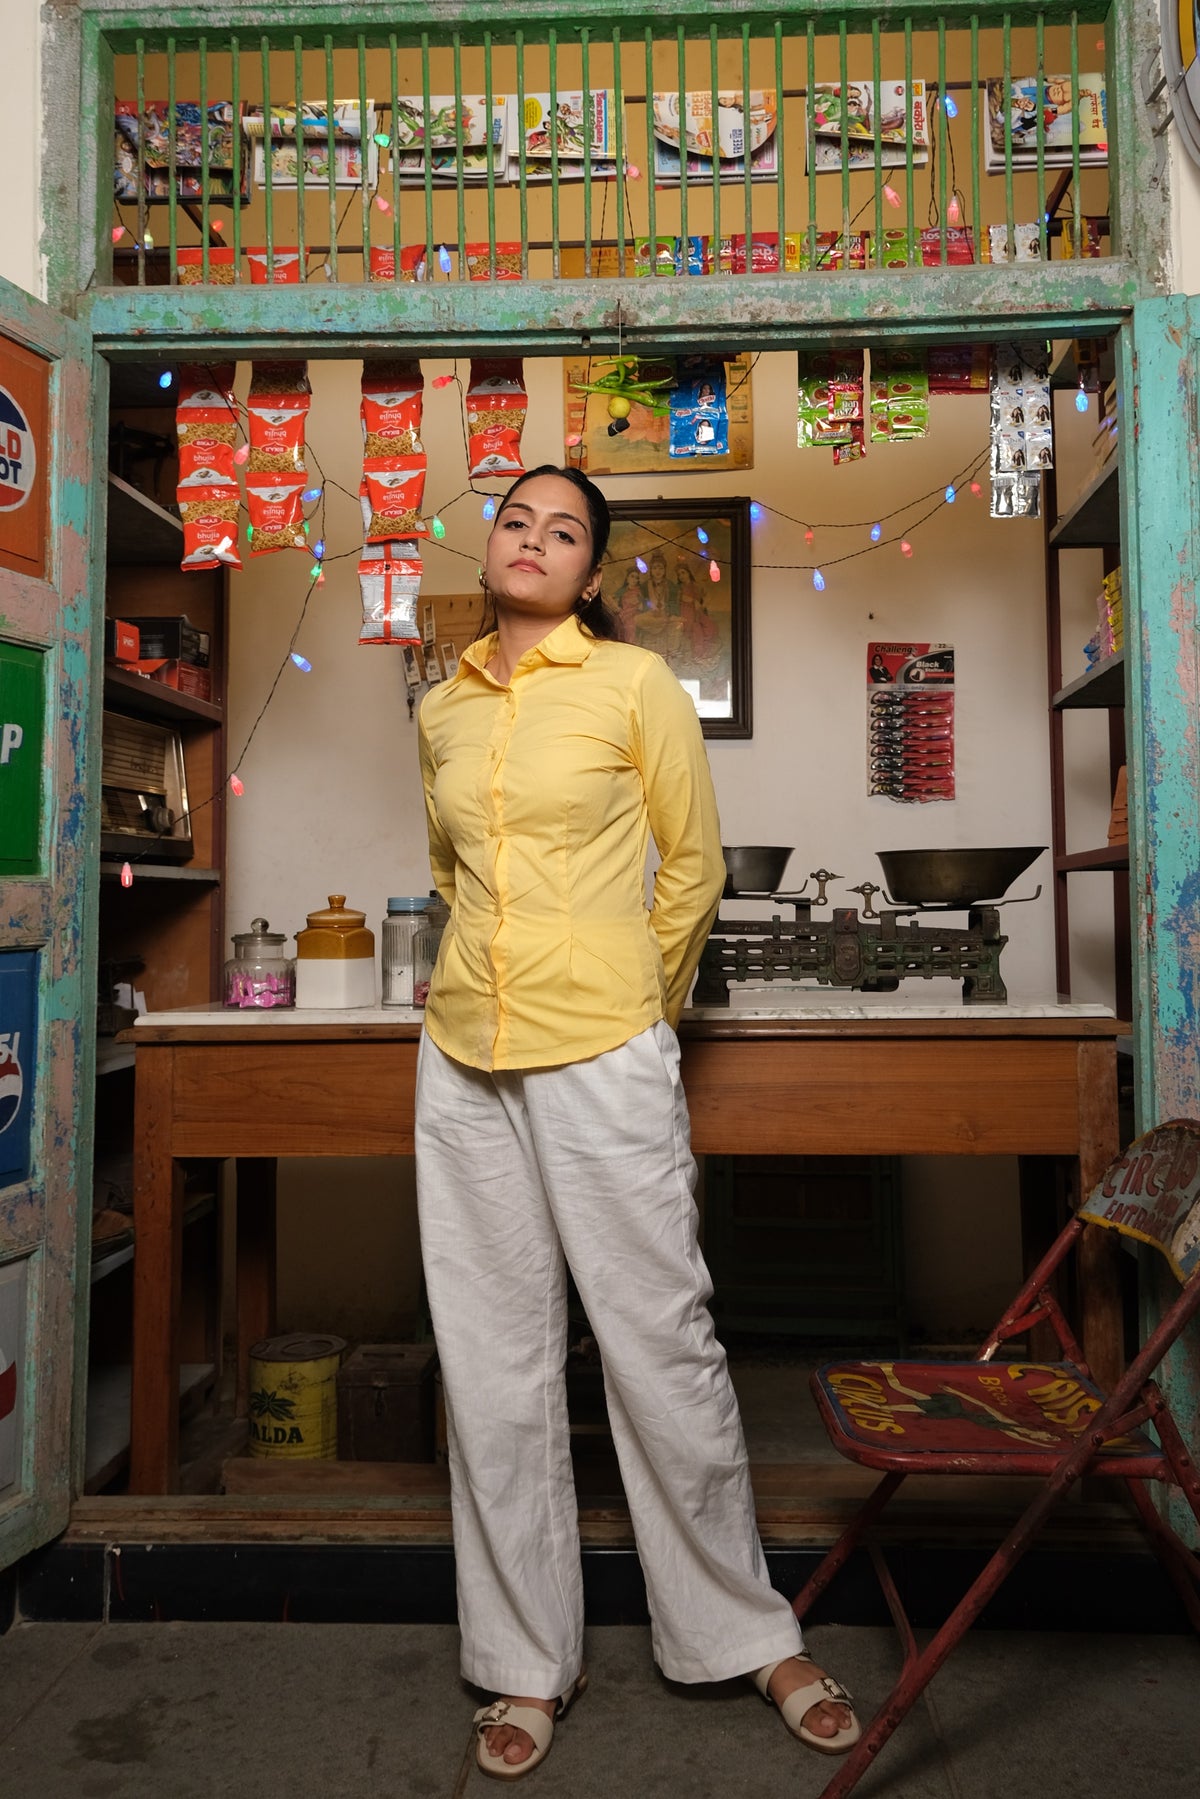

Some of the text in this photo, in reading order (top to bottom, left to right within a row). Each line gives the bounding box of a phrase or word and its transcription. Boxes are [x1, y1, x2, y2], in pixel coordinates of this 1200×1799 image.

[380, 412, 402, 421] bhujia
[264, 429, 287, 438] bhujia
[193, 454, 215, 462] bhujia
[263, 508, 285, 516] bhujia
[197, 532, 220, 540] bhujia
[1102, 1151, 1198, 1198] CIRCUS
[827, 1372, 906, 1435] CIRCUS
[249, 1422, 305, 1444] ALDA
